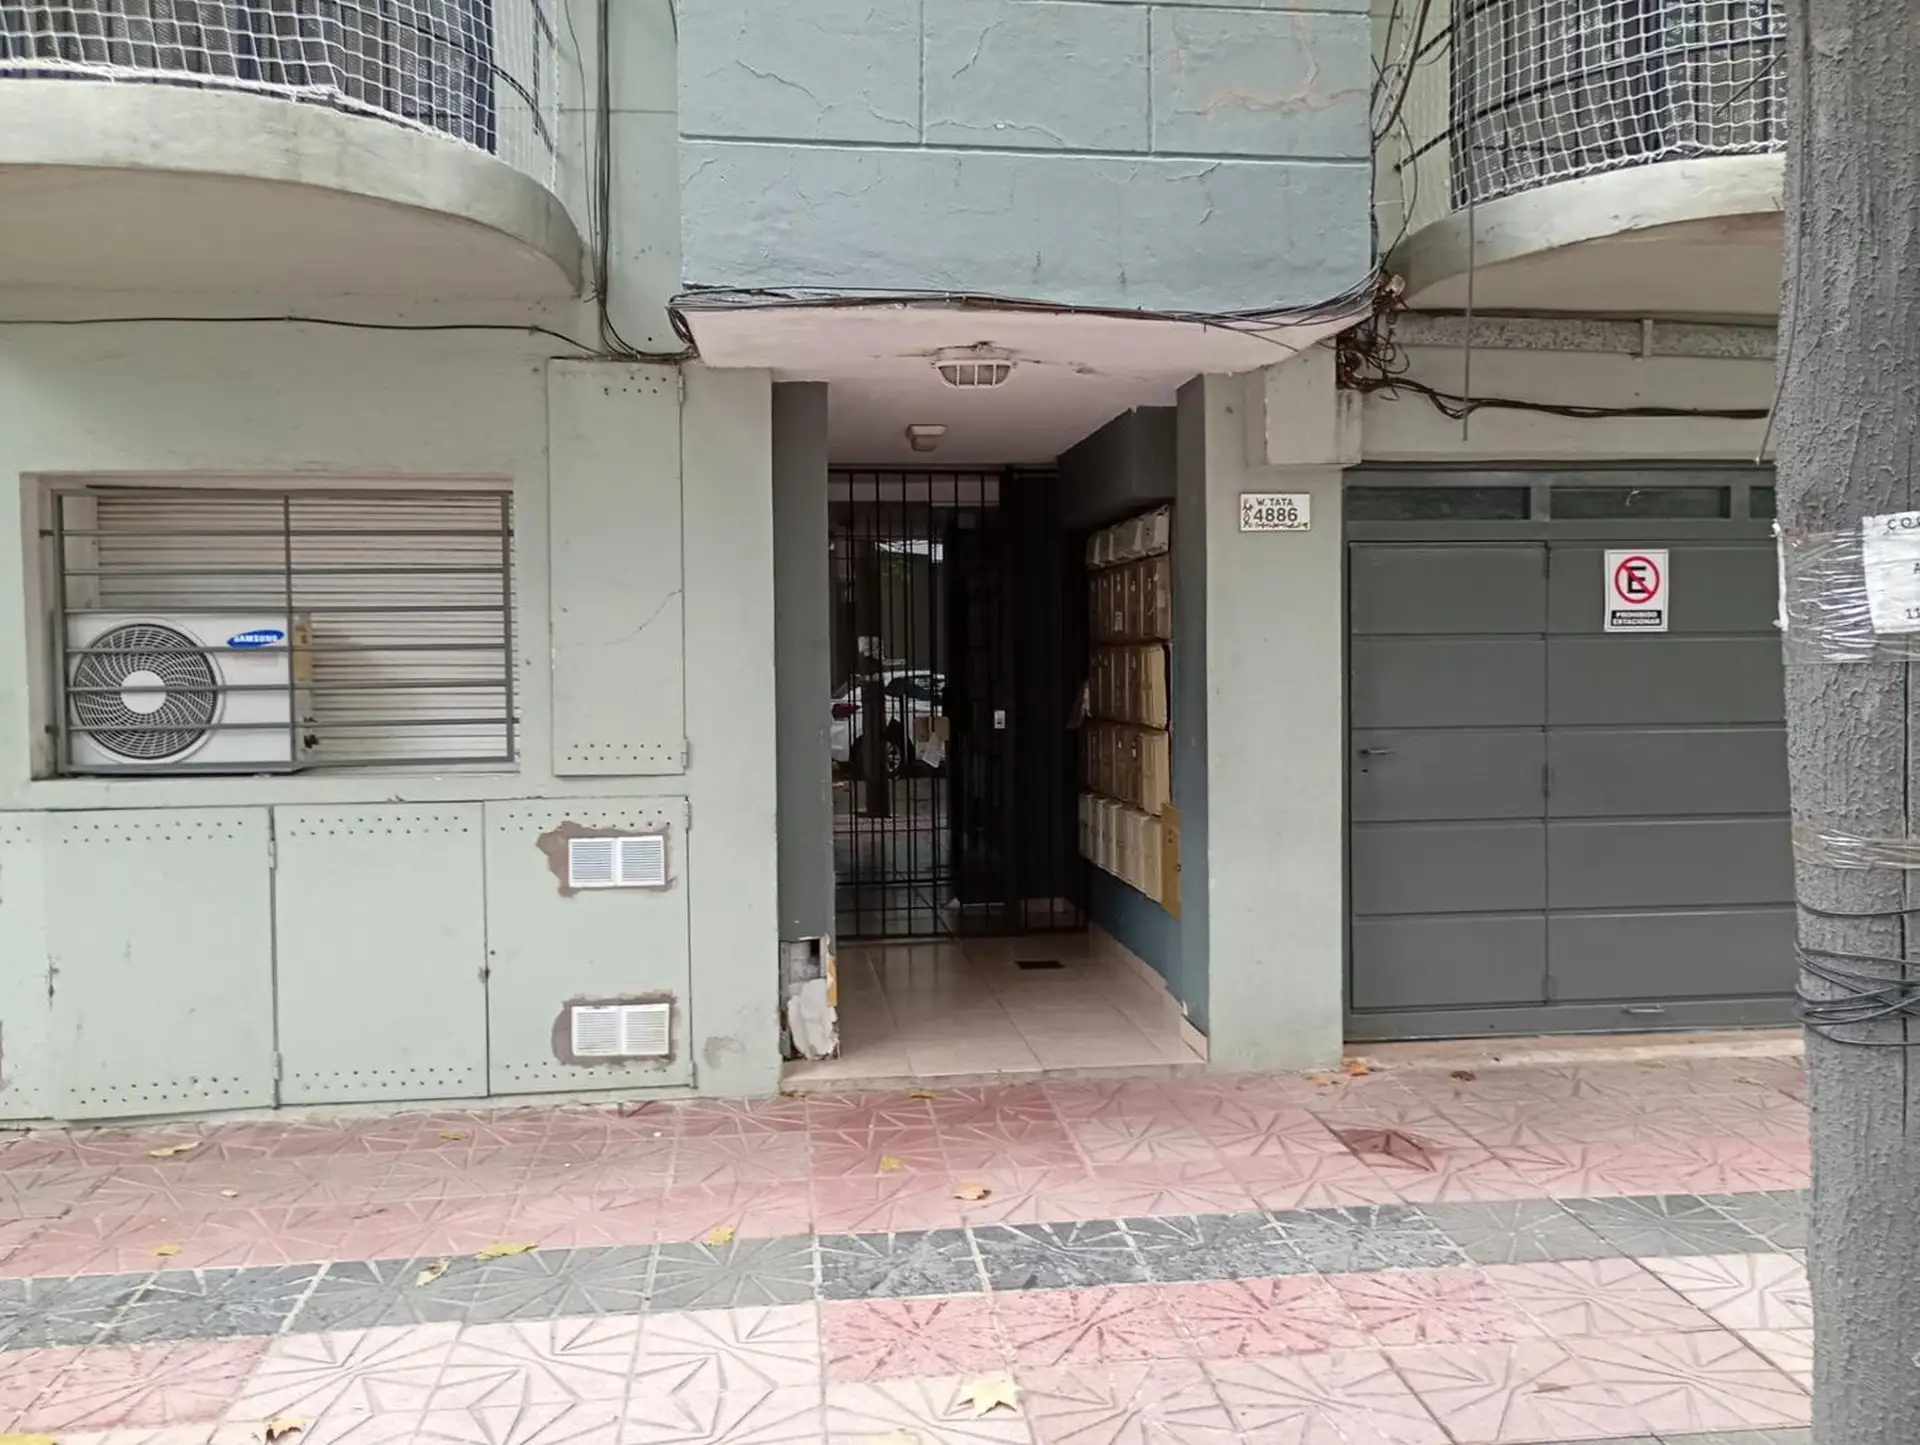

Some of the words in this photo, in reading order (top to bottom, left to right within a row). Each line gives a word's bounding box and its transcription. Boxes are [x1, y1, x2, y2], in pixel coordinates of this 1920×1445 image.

[1269, 498, 1294, 506] TATA
[1253, 507, 1298, 522] 4886
[1627, 566, 1648, 594] E
[233, 634, 278, 643] SAMSUNG
